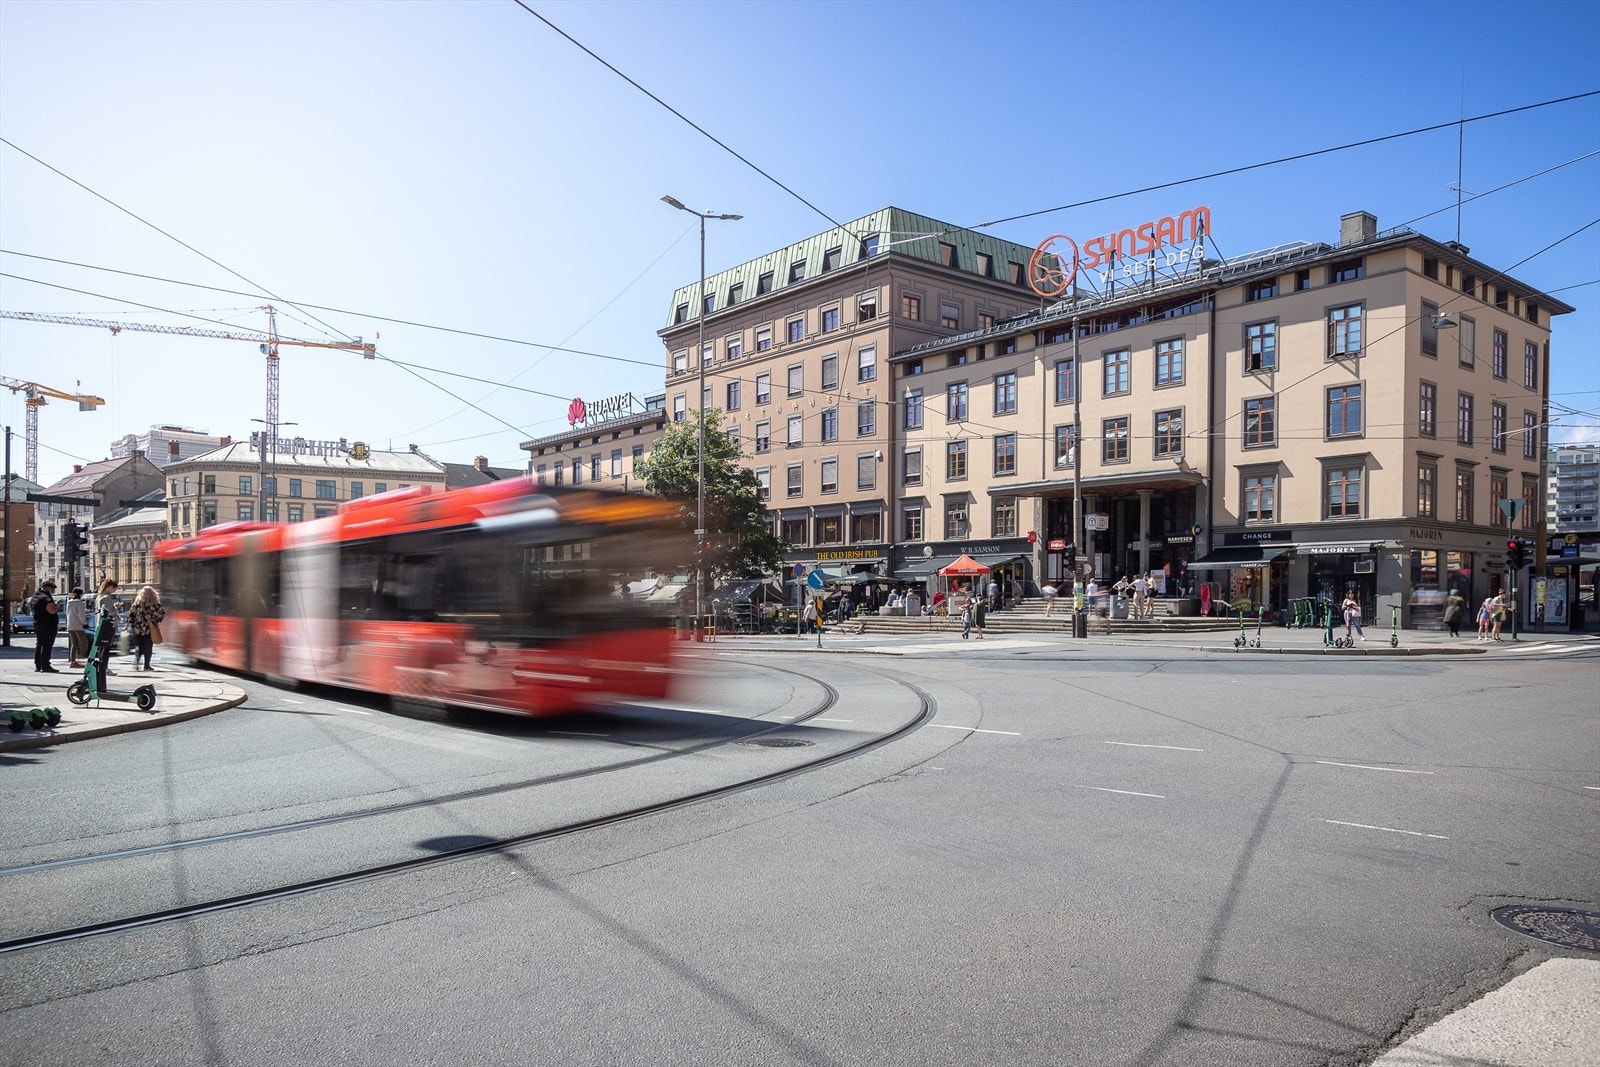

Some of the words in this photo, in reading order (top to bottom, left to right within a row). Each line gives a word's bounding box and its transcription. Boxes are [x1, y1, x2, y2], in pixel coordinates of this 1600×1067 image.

[1083, 206, 1211, 269] SYNSAM
[1099, 270, 1114, 284] VI
[1122, 257, 1157, 278] SER
[1166, 245, 1204, 267] DEG
[588, 392, 631, 417] HUAWEI
[1410, 529, 1442, 540] MAJOREN
[817, 552, 829, 560] THE
[830, 551, 844, 559] OLD
[845, 550, 864, 559] IRISH
[864, 549, 878, 558] PUB
[974, 545, 1000, 553] SAMSON
